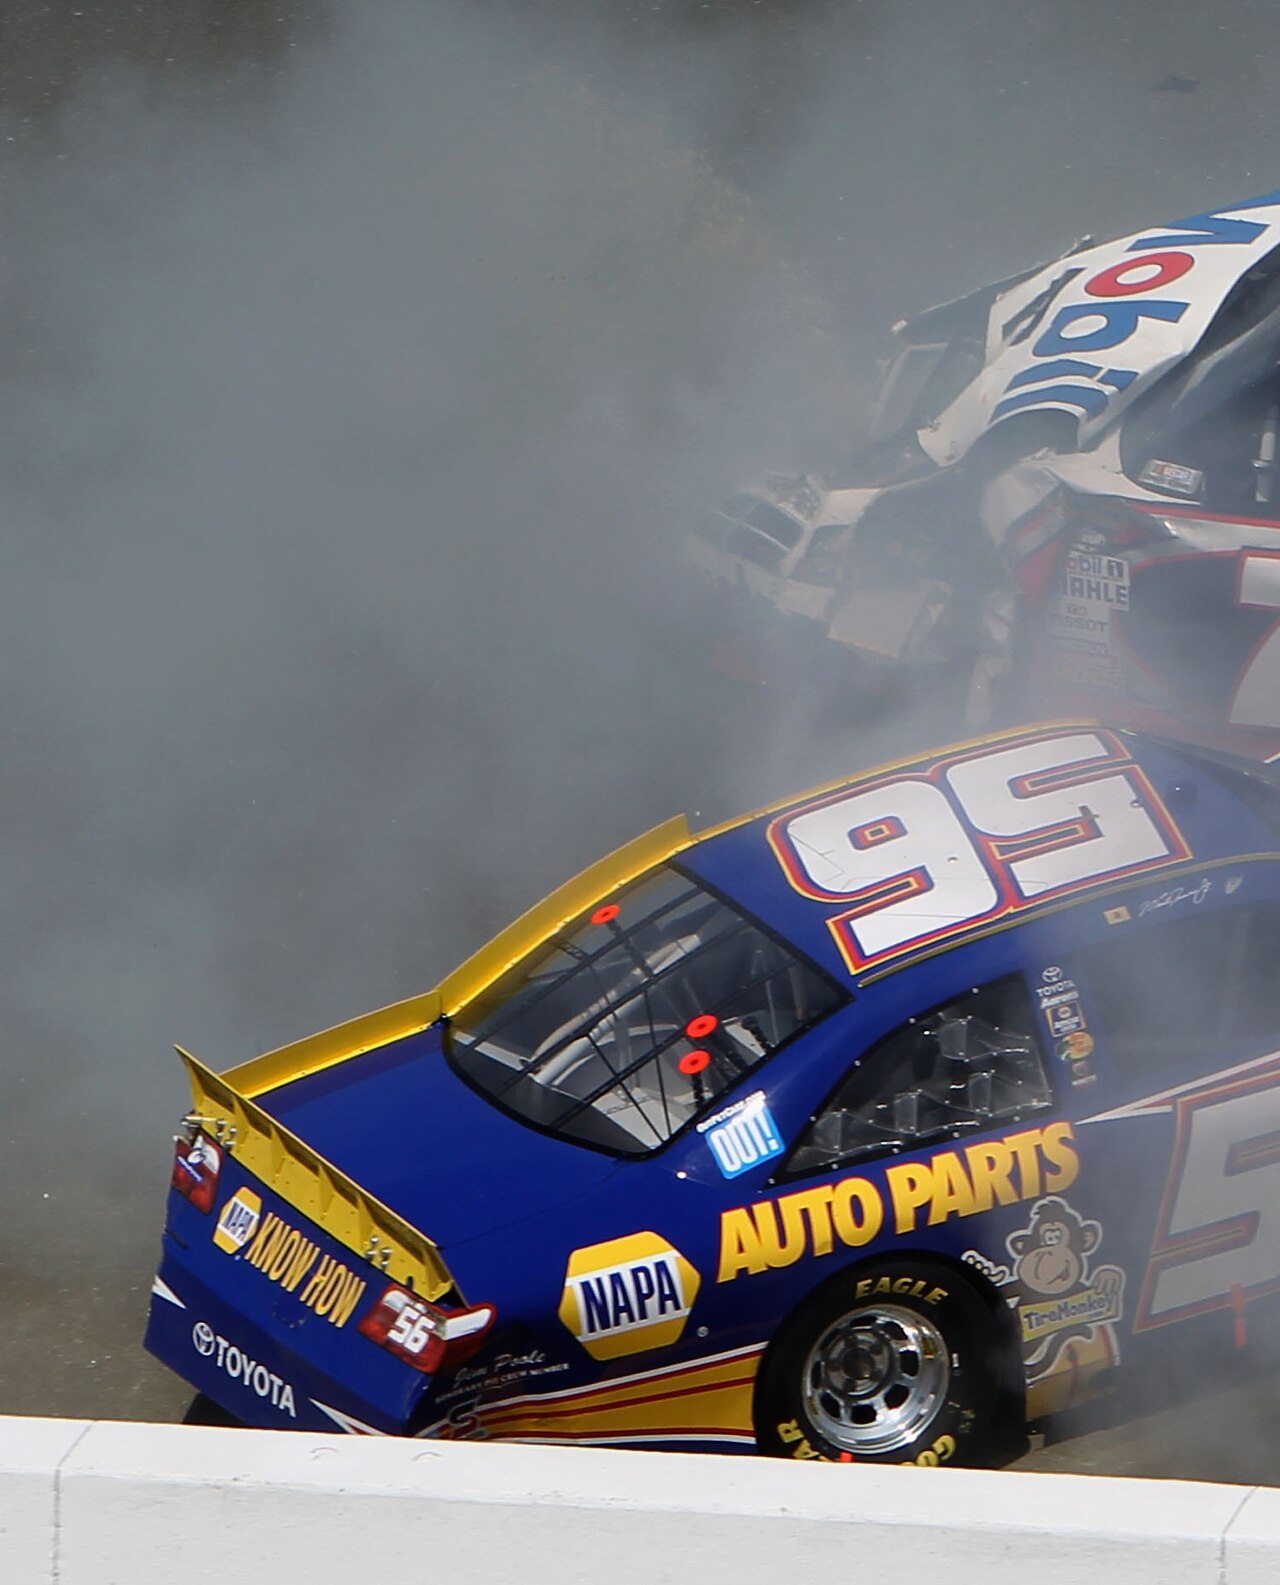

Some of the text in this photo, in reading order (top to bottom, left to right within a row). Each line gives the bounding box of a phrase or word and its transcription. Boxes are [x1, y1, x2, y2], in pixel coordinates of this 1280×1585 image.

[222, 1201, 258, 1241] NAPA
[716, 1121, 1081, 1284] AUTO PARTS
[244, 1211, 367, 1328] KNOW HOW
[580, 1260, 682, 1334] NAPA
[854, 1276, 948, 1306] EAGLE
[387, 1304, 436, 1354] 56
[215, 1335, 297, 1418] TOYOTA
